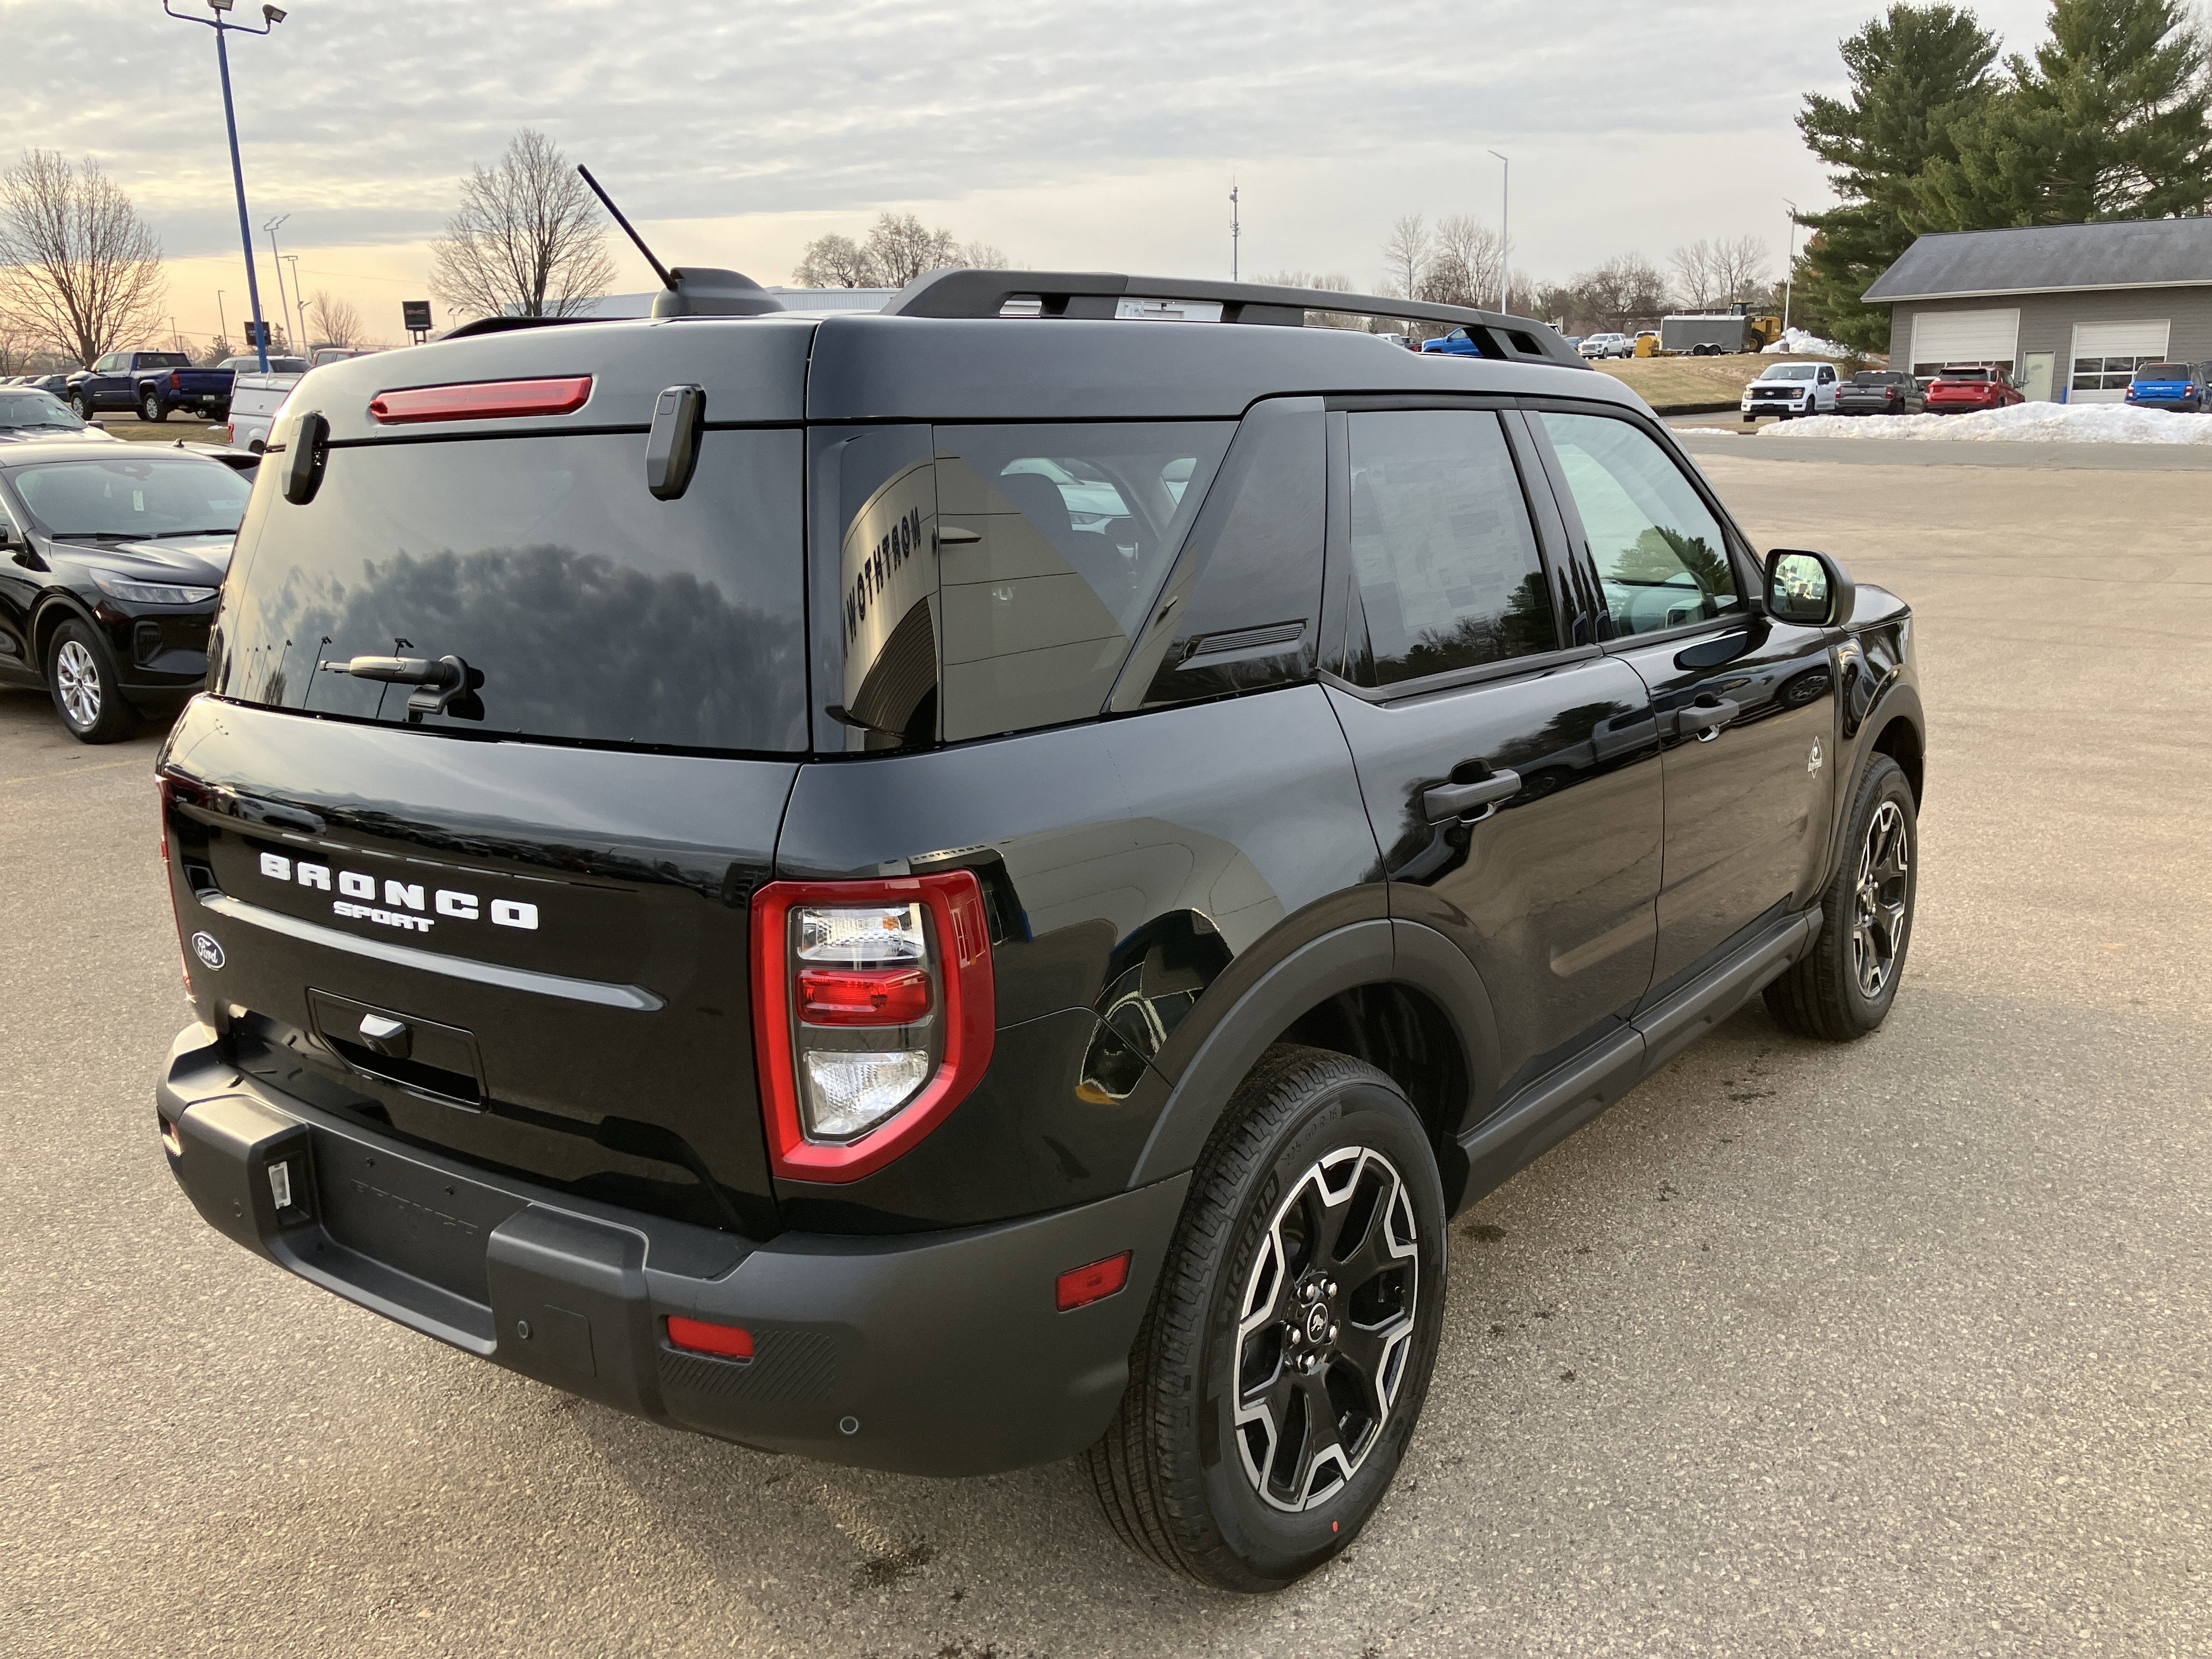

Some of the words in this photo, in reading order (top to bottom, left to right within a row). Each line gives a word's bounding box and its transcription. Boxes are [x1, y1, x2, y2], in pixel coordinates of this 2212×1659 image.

[260, 852, 539, 930] BRONCO
[333, 900, 435, 932] SPORT
[1221, 1178, 1277, 1321] MICHELIN
